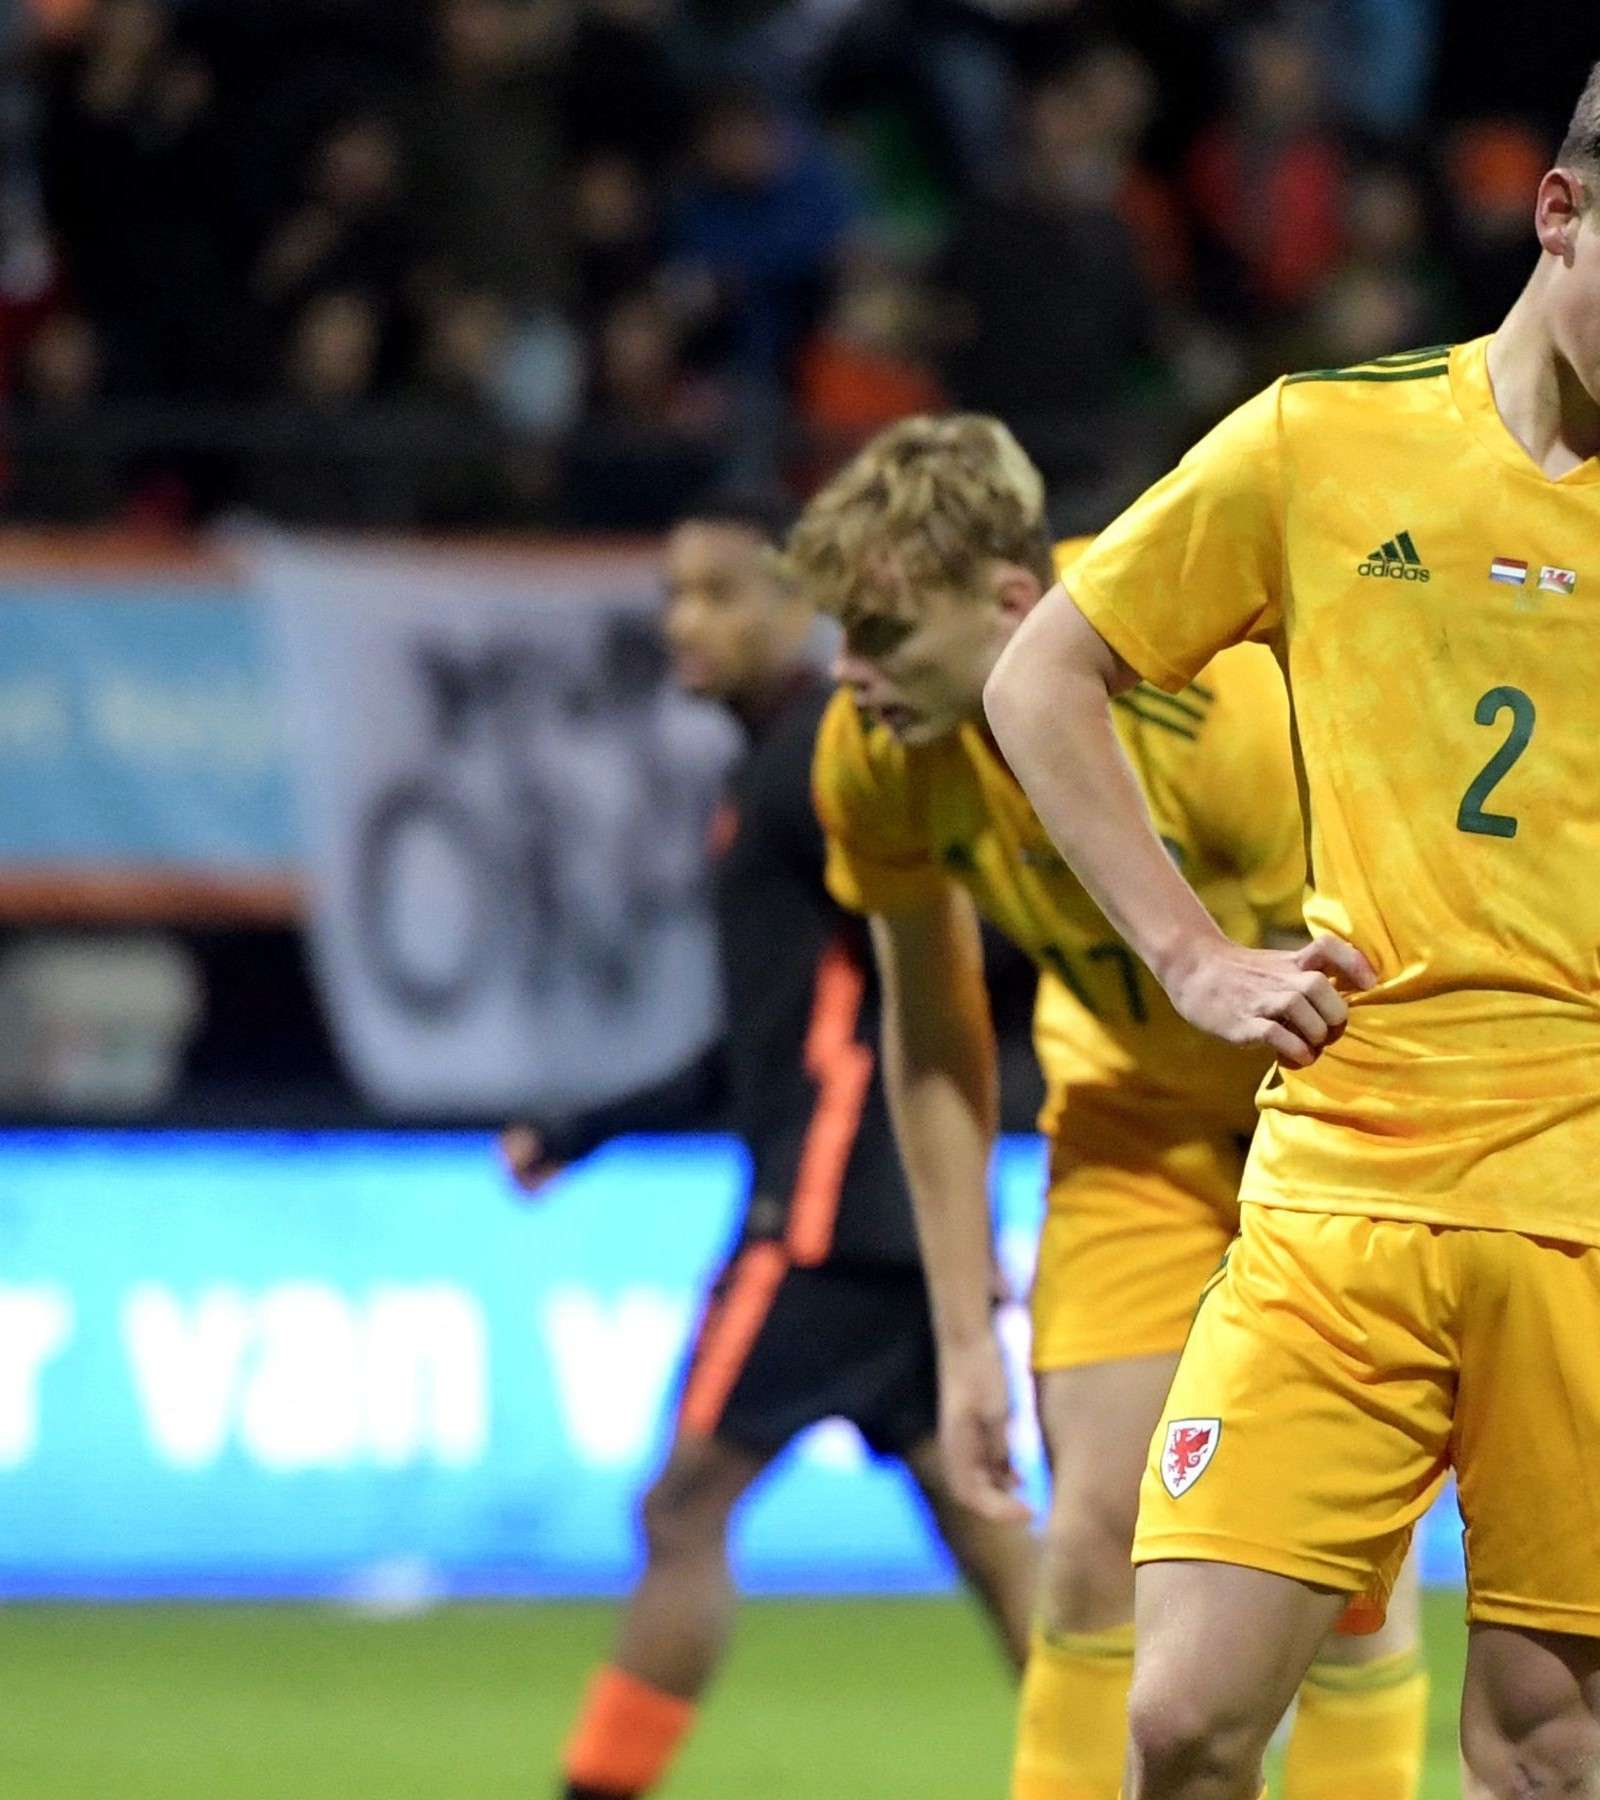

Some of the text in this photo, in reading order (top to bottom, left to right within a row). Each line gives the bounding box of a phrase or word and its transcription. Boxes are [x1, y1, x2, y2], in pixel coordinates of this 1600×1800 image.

[1358, 560, 1430, 583] adidas
[1457, 686, 1536, 838] 2
[1043, 943, 1147, 1022] 17
[122, 1282, 488, 1468] van
